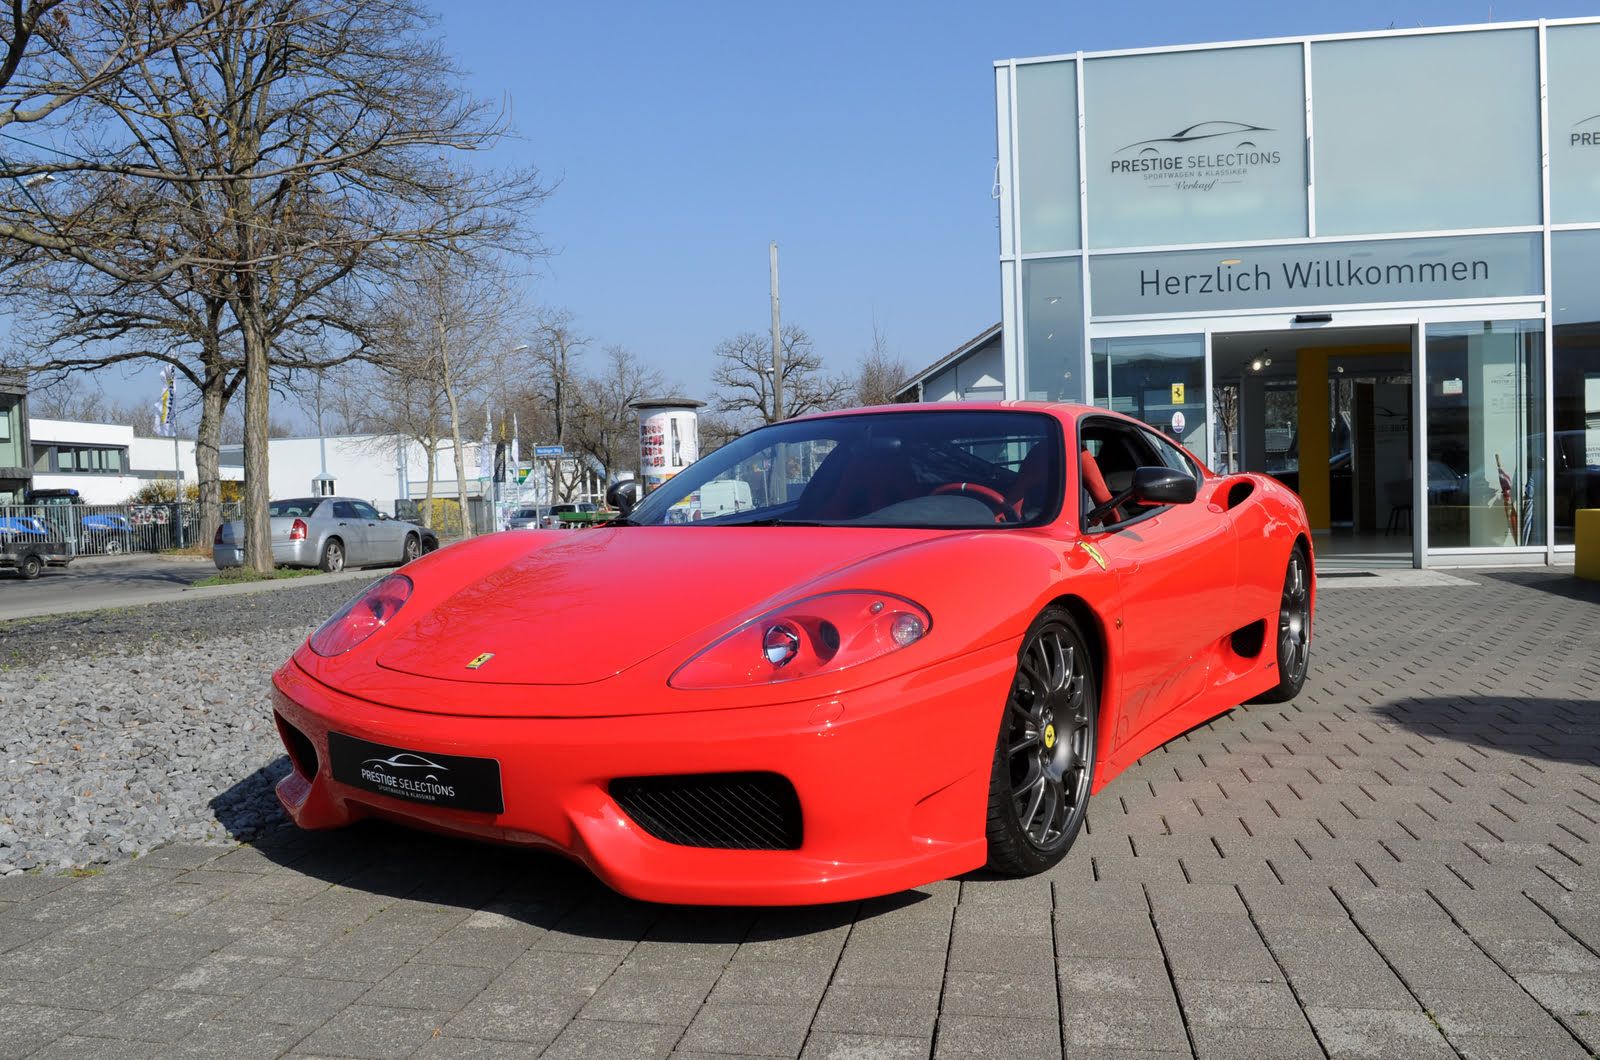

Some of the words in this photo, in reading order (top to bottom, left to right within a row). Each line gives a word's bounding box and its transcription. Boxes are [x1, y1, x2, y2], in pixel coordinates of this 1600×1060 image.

[1571, 132, 1600, 146] PRE
[1111, 157, 1183, 173] PRESTIGE
[1187, 151, 1281, 169] SELECTIONS
[1143, 171, 1195, 181] SPORTWAGEN
[1205, 168, 1248, 177] KLASSIKER
[1175, 179, 1219, 191] Verkauf
[1140, 264, 1271, 296] Herzlich
[1282, 259, 1489, 289] Willkommen
[361, 768, 398, 787] PRESTIGE
[399, 778, 456, 797] SELECTIONS
